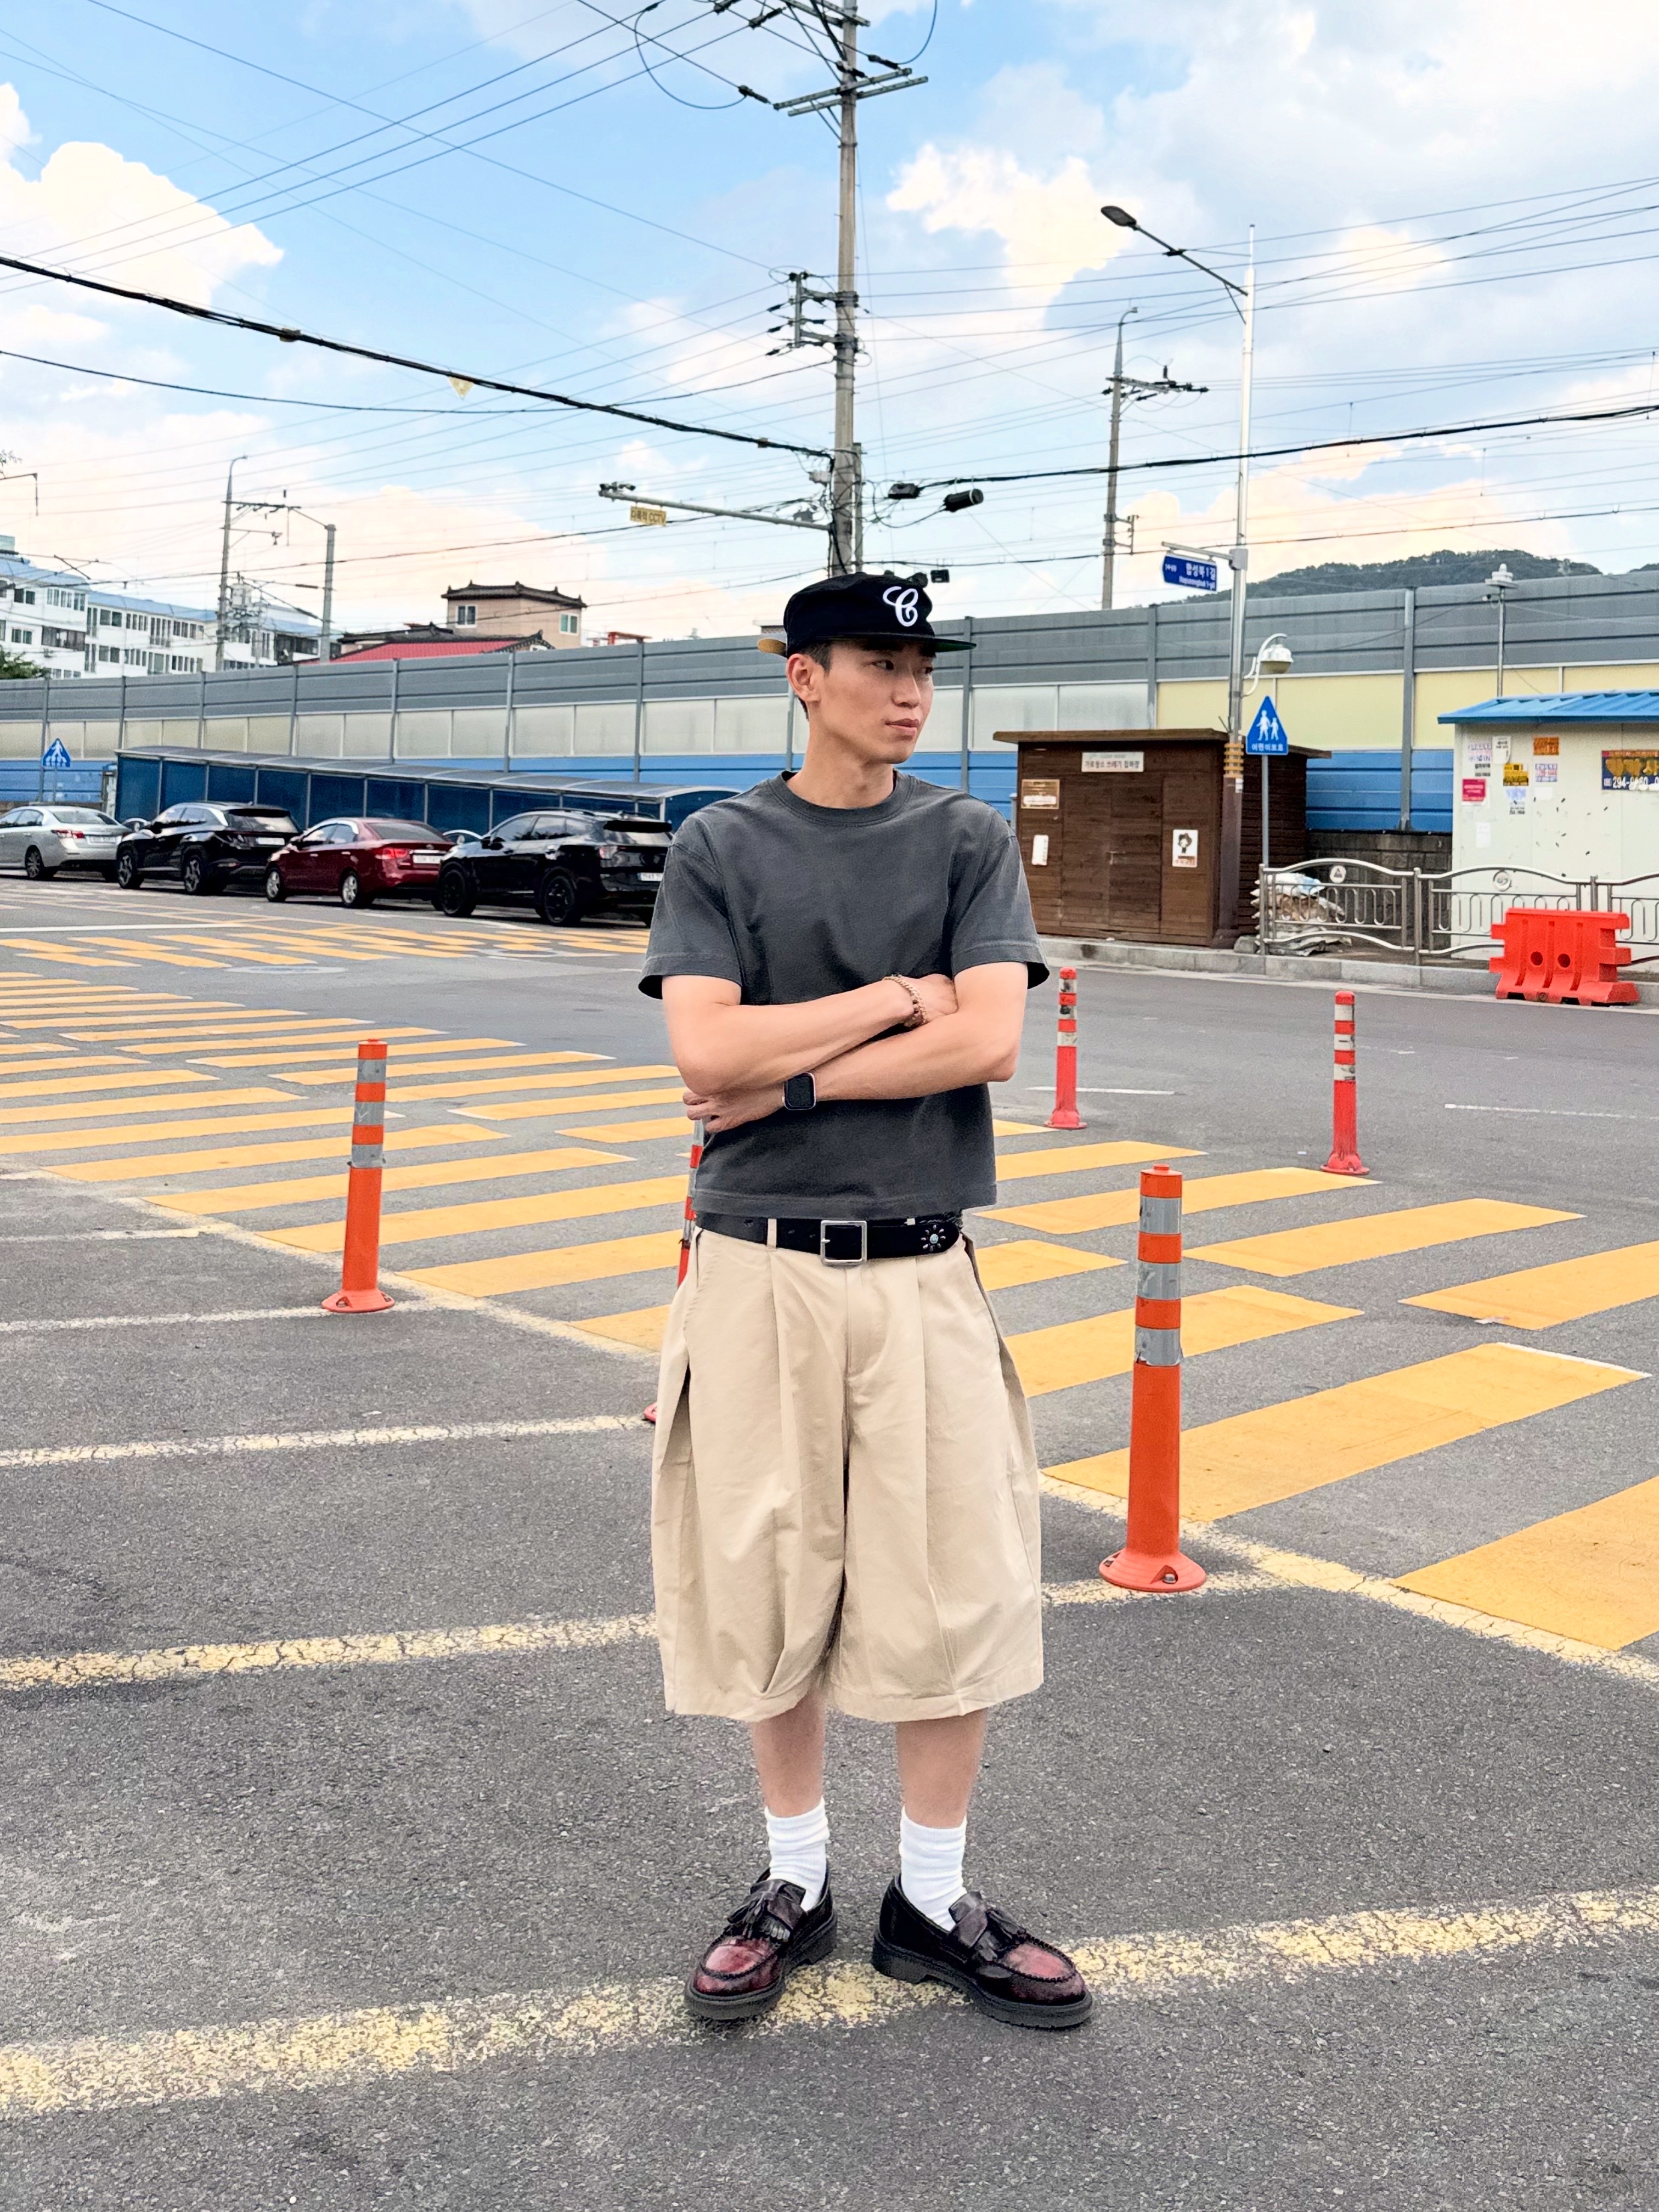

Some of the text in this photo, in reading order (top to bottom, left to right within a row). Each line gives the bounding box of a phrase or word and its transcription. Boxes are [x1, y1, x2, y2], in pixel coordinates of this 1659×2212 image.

[649, 512, 666, 523] CCTV
[1251, 743, 1283, 752] 어린이보호
[1106, 760, 1122, 769] 쓰레기
